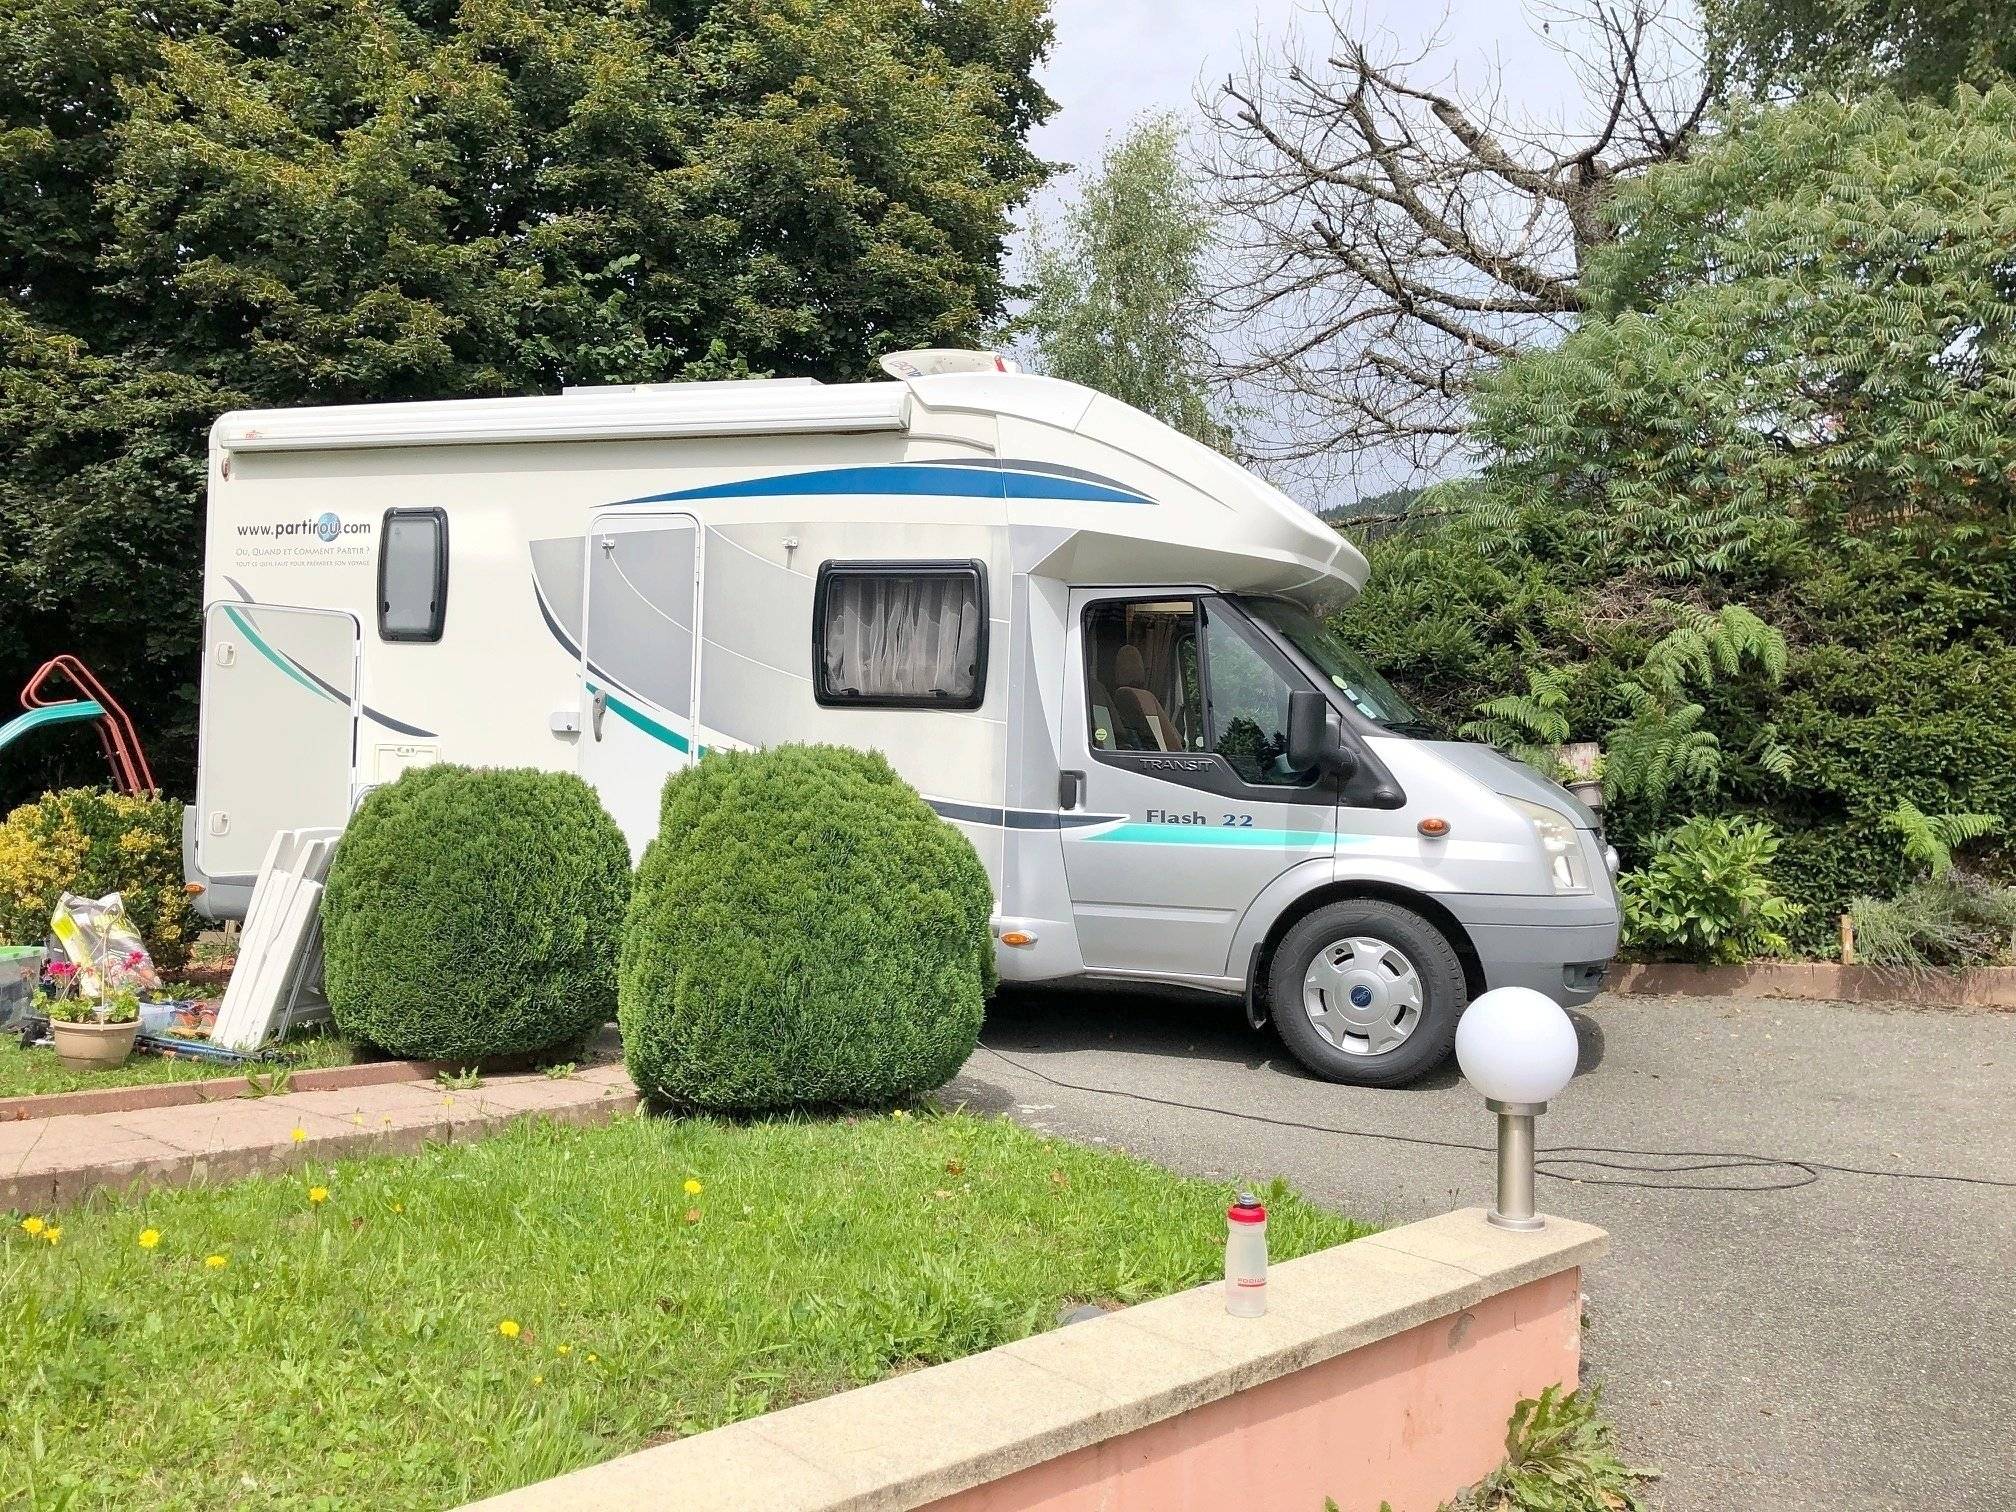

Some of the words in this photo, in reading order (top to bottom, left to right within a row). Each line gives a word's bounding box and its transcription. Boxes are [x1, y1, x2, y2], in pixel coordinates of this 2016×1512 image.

[236, 518, 371, 540] www.partirou.com
[252, 547, 281, 556] QUAND
[283, 548, 293, 556] ET
[293, 547, 334, 555] COMMENT
[336, 546, 364, 555] PARTIR
[1140, 759, 1213, 772] TRANSIT
[1146, 809, 1207, 825] Flash
[1222, 814, 1253, 827] 22
